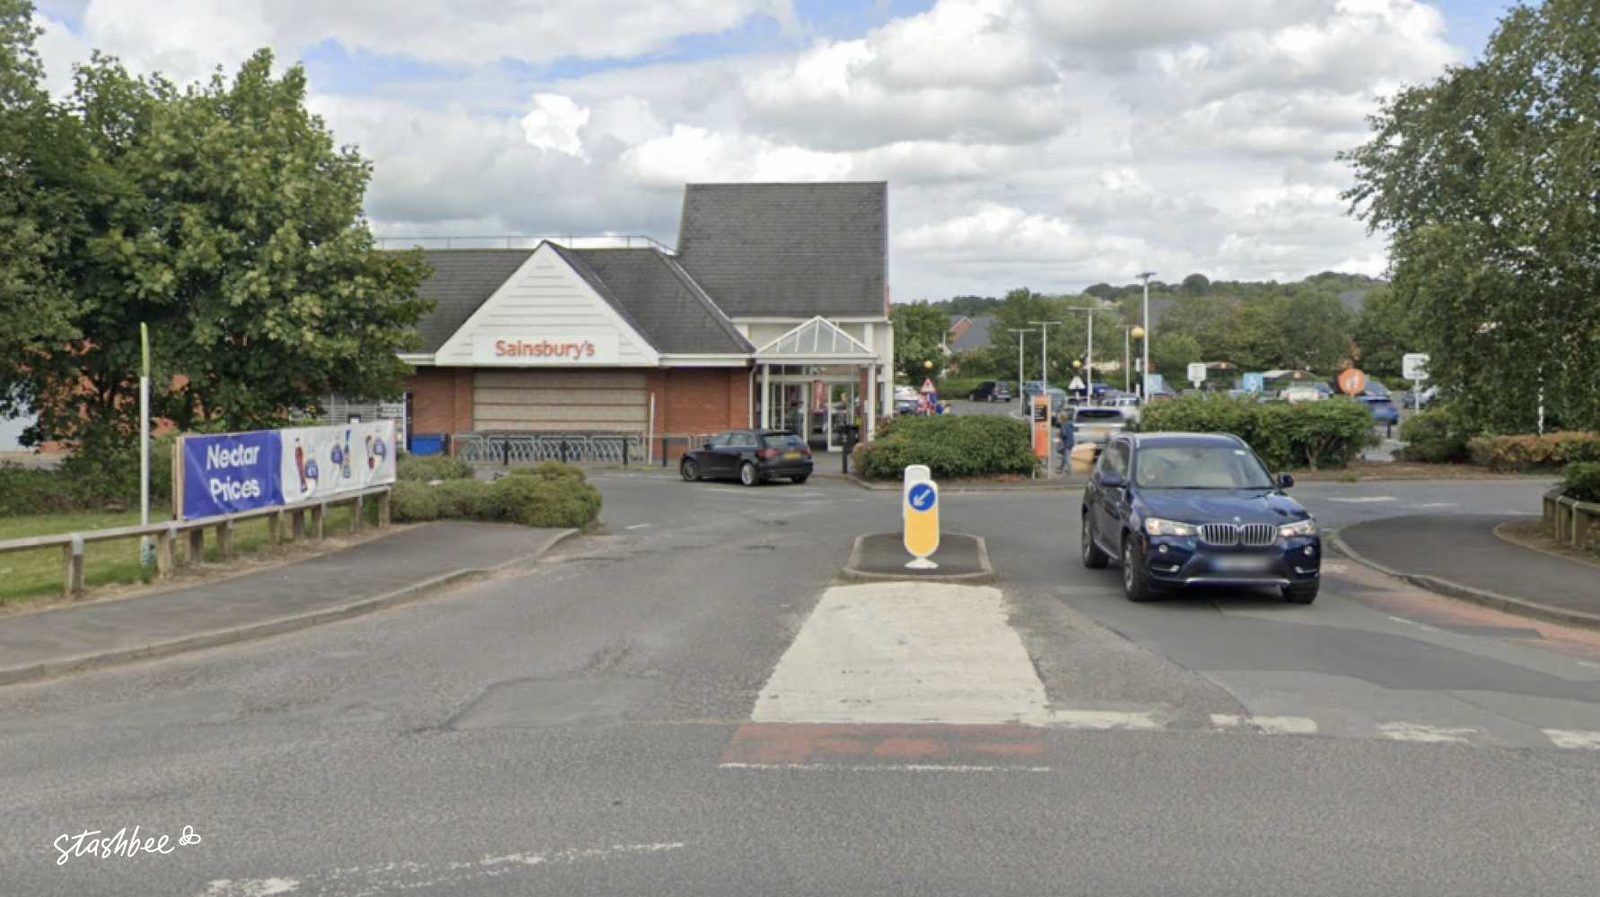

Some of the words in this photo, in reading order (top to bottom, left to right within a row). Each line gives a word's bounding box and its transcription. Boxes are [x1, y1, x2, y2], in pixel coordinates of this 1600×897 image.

[495, 339, 595, 360] Sainsbury's
[207, 443, 260, 470] Nectar
[210, 475, 261, 504] Prices
